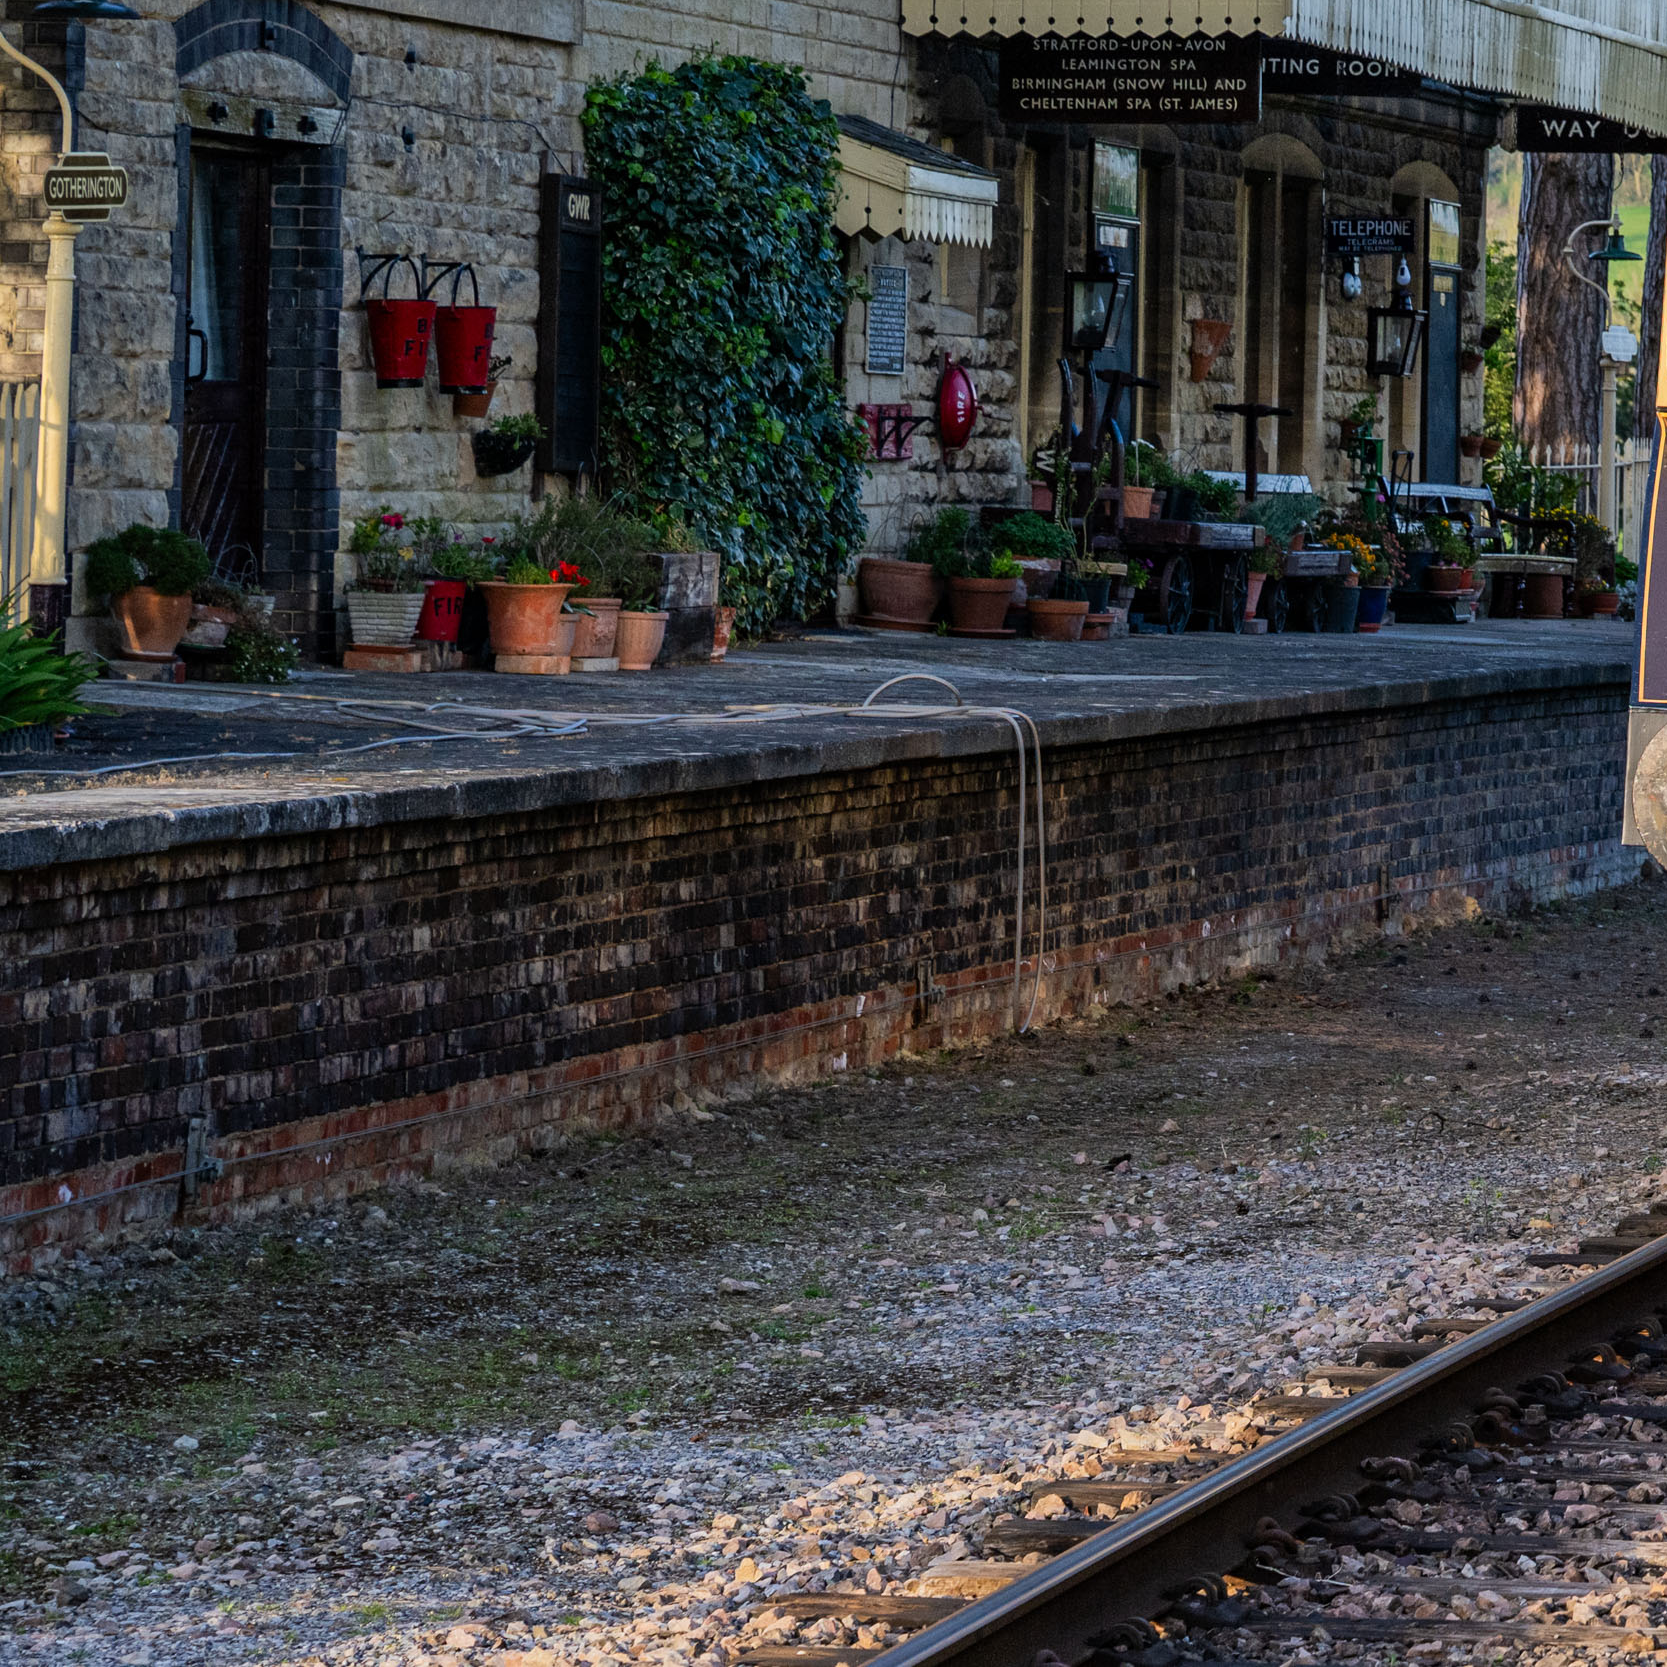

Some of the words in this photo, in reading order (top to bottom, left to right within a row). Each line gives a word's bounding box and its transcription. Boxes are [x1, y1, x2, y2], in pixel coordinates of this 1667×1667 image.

[1033, 39, 1227, 52] STRATFORD-UPON-AVON
[1062, 58, 1161, 71] LEAMINGTON
[1170, 58, 1197, 71] SPA
[1262, 57, 1320, 75] ITING
[1336, 59, 1400, 78] ROOM
[1011, 78, 1106, 91] BIRMINGHAM
[1113, 77, 1165, 92] (SNOW
[1173, 77, 1208, 92] HILL)
[1214, 78, 1247, 91] AND
[1019, 97, 1118, 110] CHELTENHAM
[1126, 97, 1152, 110] SPA
[1159, 97, 1183, 112] (ST.
[1190, 97, 1238, 112] JAMES)
[1541, 119, 1601, 138] WAY
[49, 176, 123, 199] GOTHERINGTON
[568, 192, 591, 221] GWR
[1330, 220, 1411, 236] TELEPHONE
[1347, 238, 1394, 246] TELEGRAMS
[957, 389, 968, 424] FIRE
